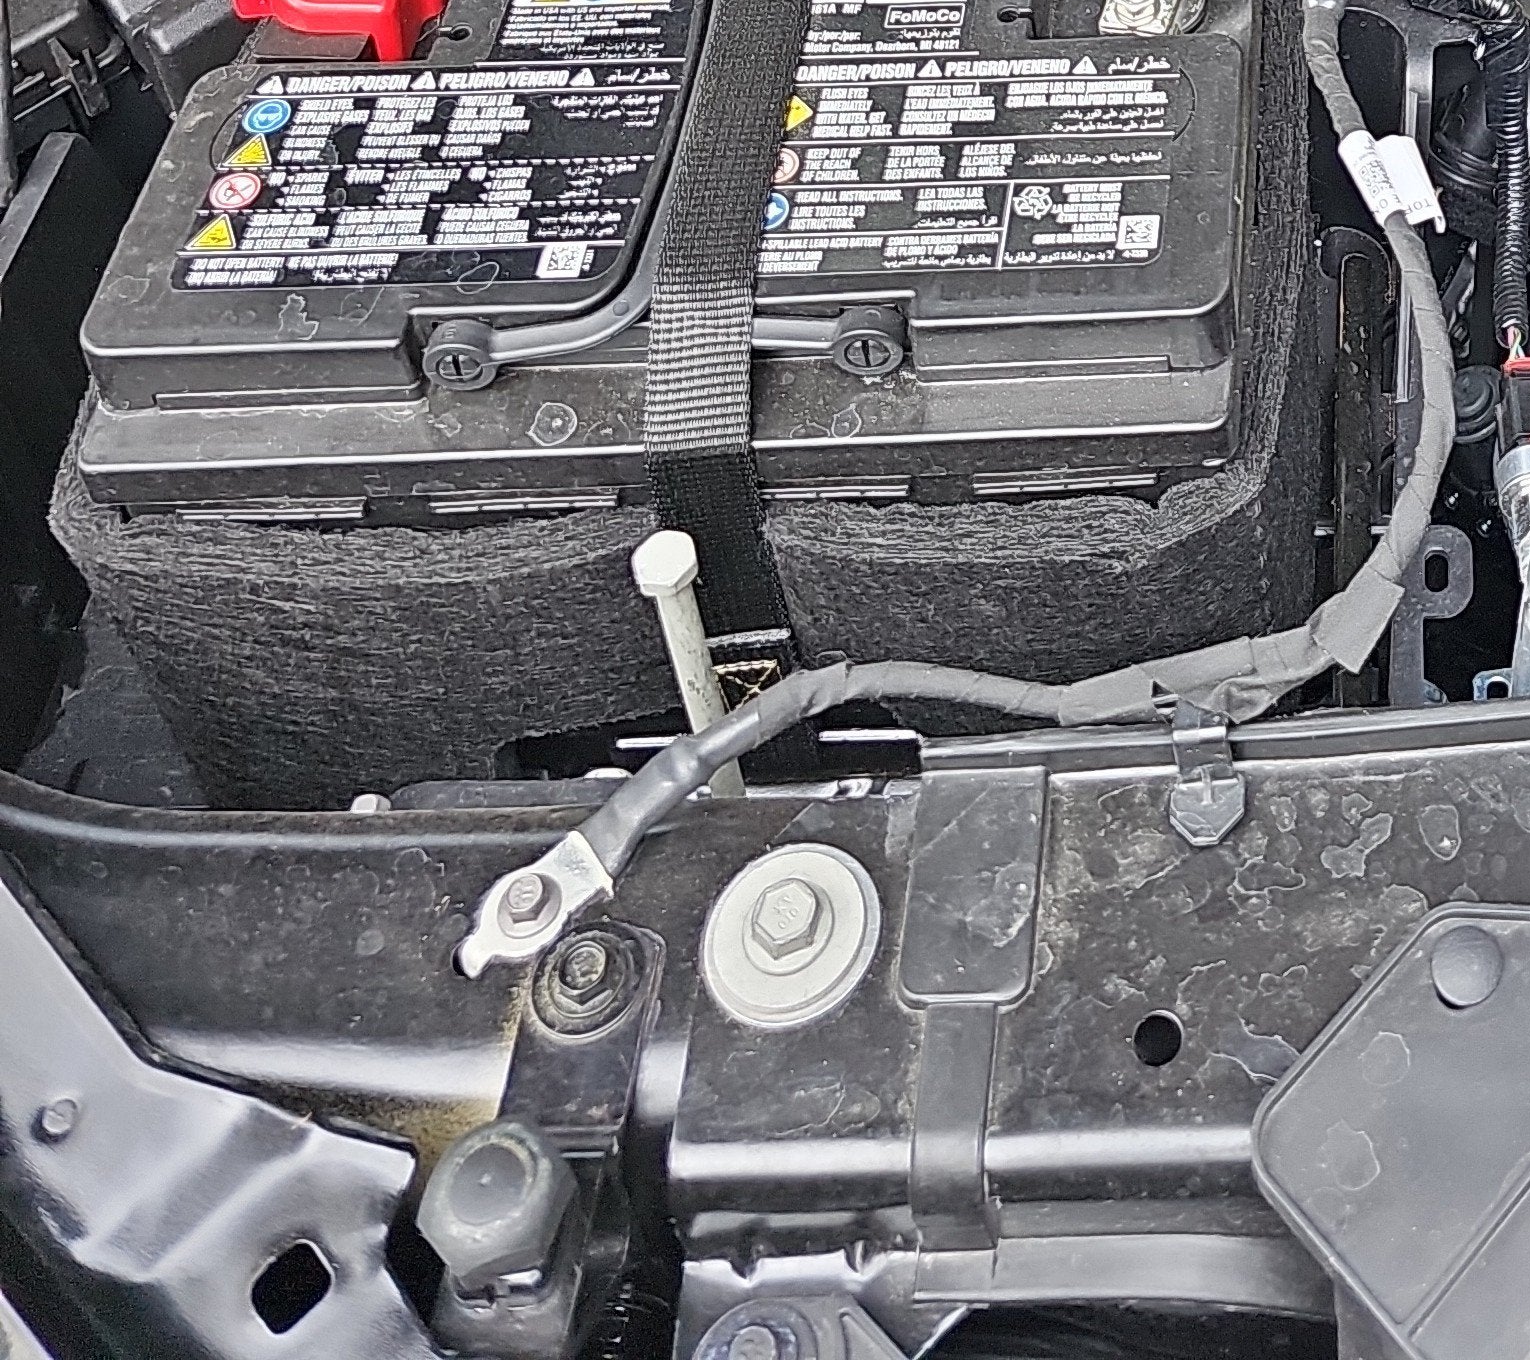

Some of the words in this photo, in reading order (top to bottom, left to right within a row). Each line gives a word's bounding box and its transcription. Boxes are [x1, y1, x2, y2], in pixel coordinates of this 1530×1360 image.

[889, 9, 961, 24] FoMoCo
[285, 73, 412, 94] DANGER/POISON
[438, 69, 571, 91] PELIGRO/VENENO
[796, 62, 917, 82] DANGER/POISON
[944, 58, 1072, 78] PELIGRO/VENENO
